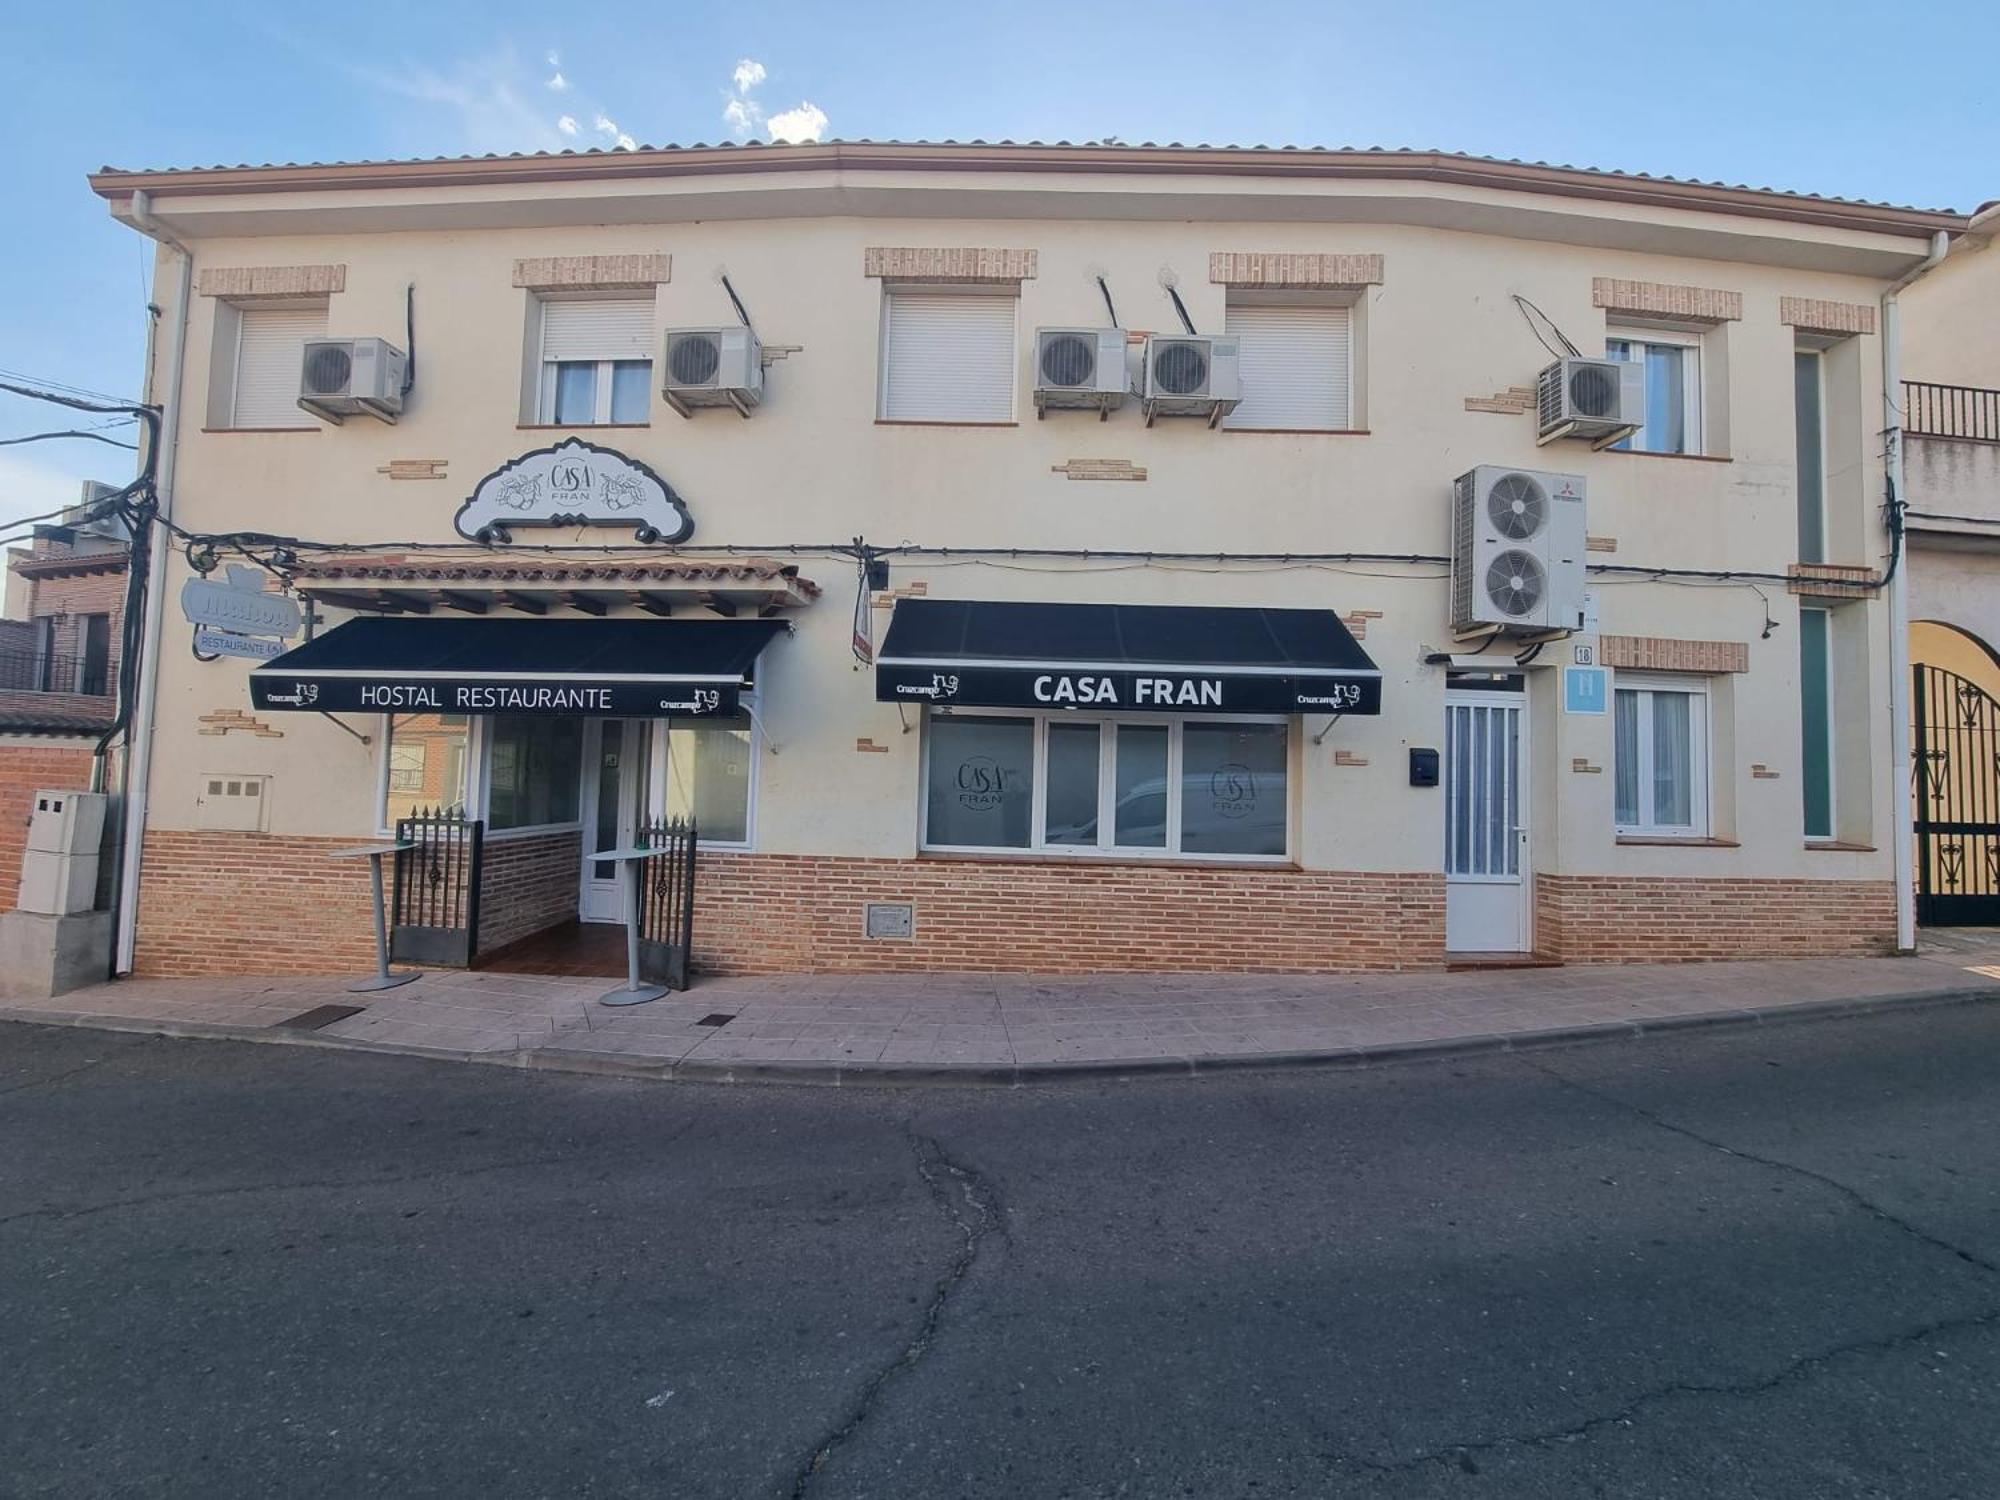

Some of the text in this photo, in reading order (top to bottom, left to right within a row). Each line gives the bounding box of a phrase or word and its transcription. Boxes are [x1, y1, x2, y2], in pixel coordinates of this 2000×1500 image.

[551, 464, 591, 492] CASA
[1579, 648, 1590, 661] 18
[897, 684, 940, 695] Cruzcampo
[1033, 676, 1223, 706] CASA FRAN
[361, 686, 613, 709] HOSTAL RESTAURANTE
[1297, 694, 1341, 705] Cruzcampo
[660, 701, 701, 711] Cruzcampo
